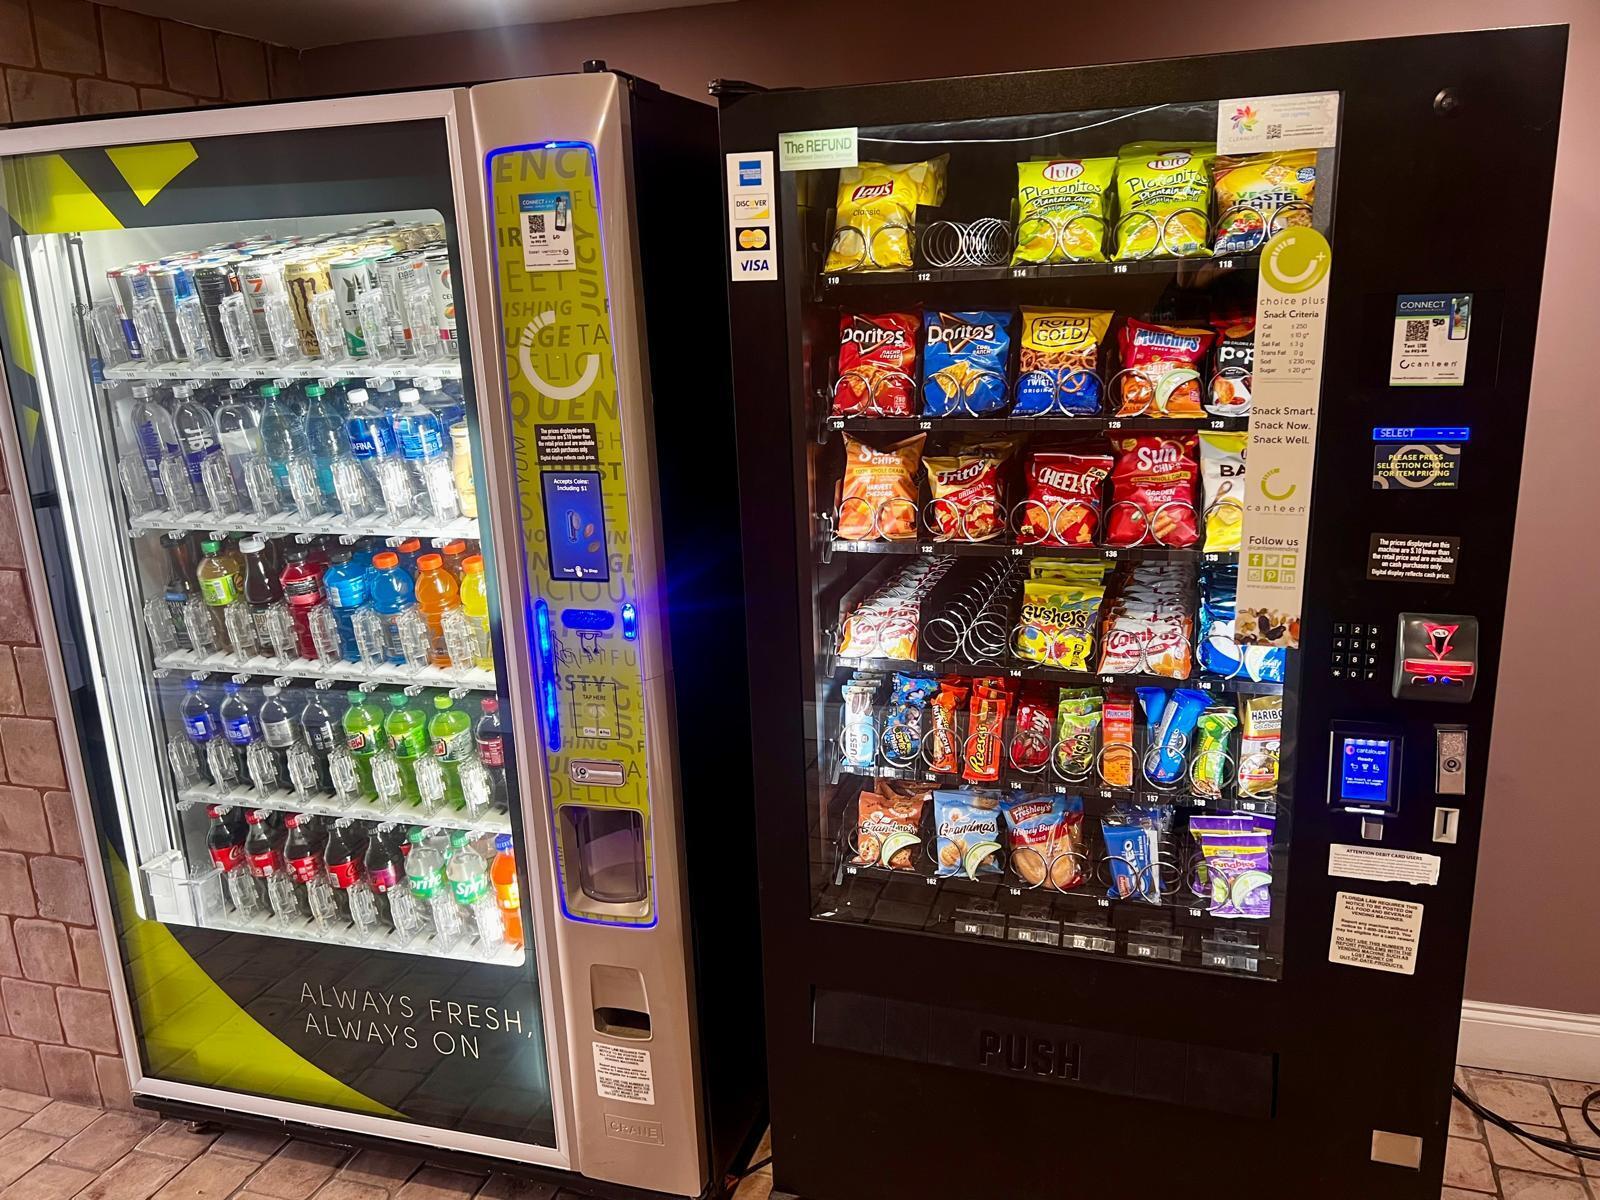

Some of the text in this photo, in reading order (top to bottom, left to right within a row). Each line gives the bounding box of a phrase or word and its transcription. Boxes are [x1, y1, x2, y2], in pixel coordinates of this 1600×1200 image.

[784, 138, 852, 154] The REFUND
[1126, 168, 1210, 192] Platanitos
[1021, 180, 1101, 200] Platanitos
[1033, 197, 1071, 208] Plantain
[741, 260, 769, 272] VISA
[1260, 297, 1325, 306] choice plus
[1264, 310, 1319, 318] Snack Criteria
[1038, 318, 1086, 328] ROLD
[841, 328, 905, 344] Doritos
[928, 324, 994, 346] Doritos
[1036, 327, 1082, 342] GOLD
[1134, 328, 1200, 352] MUNCHIES
[1252, 407, 1315, 415] Snack Smart.
[1254, 421, 1283, 429] Snack
[1253, 436, 1309, 444] Snack Well.
[1380, 428, 1415, 438] SELECT
[871, 456, 901, 466] CHIPS
[1137, 448, 1176, 471] Sun
[938, 460, 986, 486] Fritos
[1247, 504, 1305, 512] canteen
[1249, 536, 1298, 546] Follow us
[1390, 540, 1406, 548] prices
[1407, 540, 1432, 548] displayed
[1022, 604, 1088, 628] Gushers
[1110, 628, 1178, 648] Combos
[1252, 710, 1282, 720] HARIBO
[969, 724, 987, 774] Reese's
[1013, 803, 1051, 820] Freshley's
[861, 822, 917, 834] Grandma's
[940, 821, 995, 836] Grandma's
[1013, 823, 1036, 836] Honey
[300, 982, 533, 1038] ALWAYS FRESH,
[306, 1013, 480, 1059] ALWAYS ON
[980, 1031, 1081, 1080] PUSH
[610, 1121, 658, 1138] CRANE
